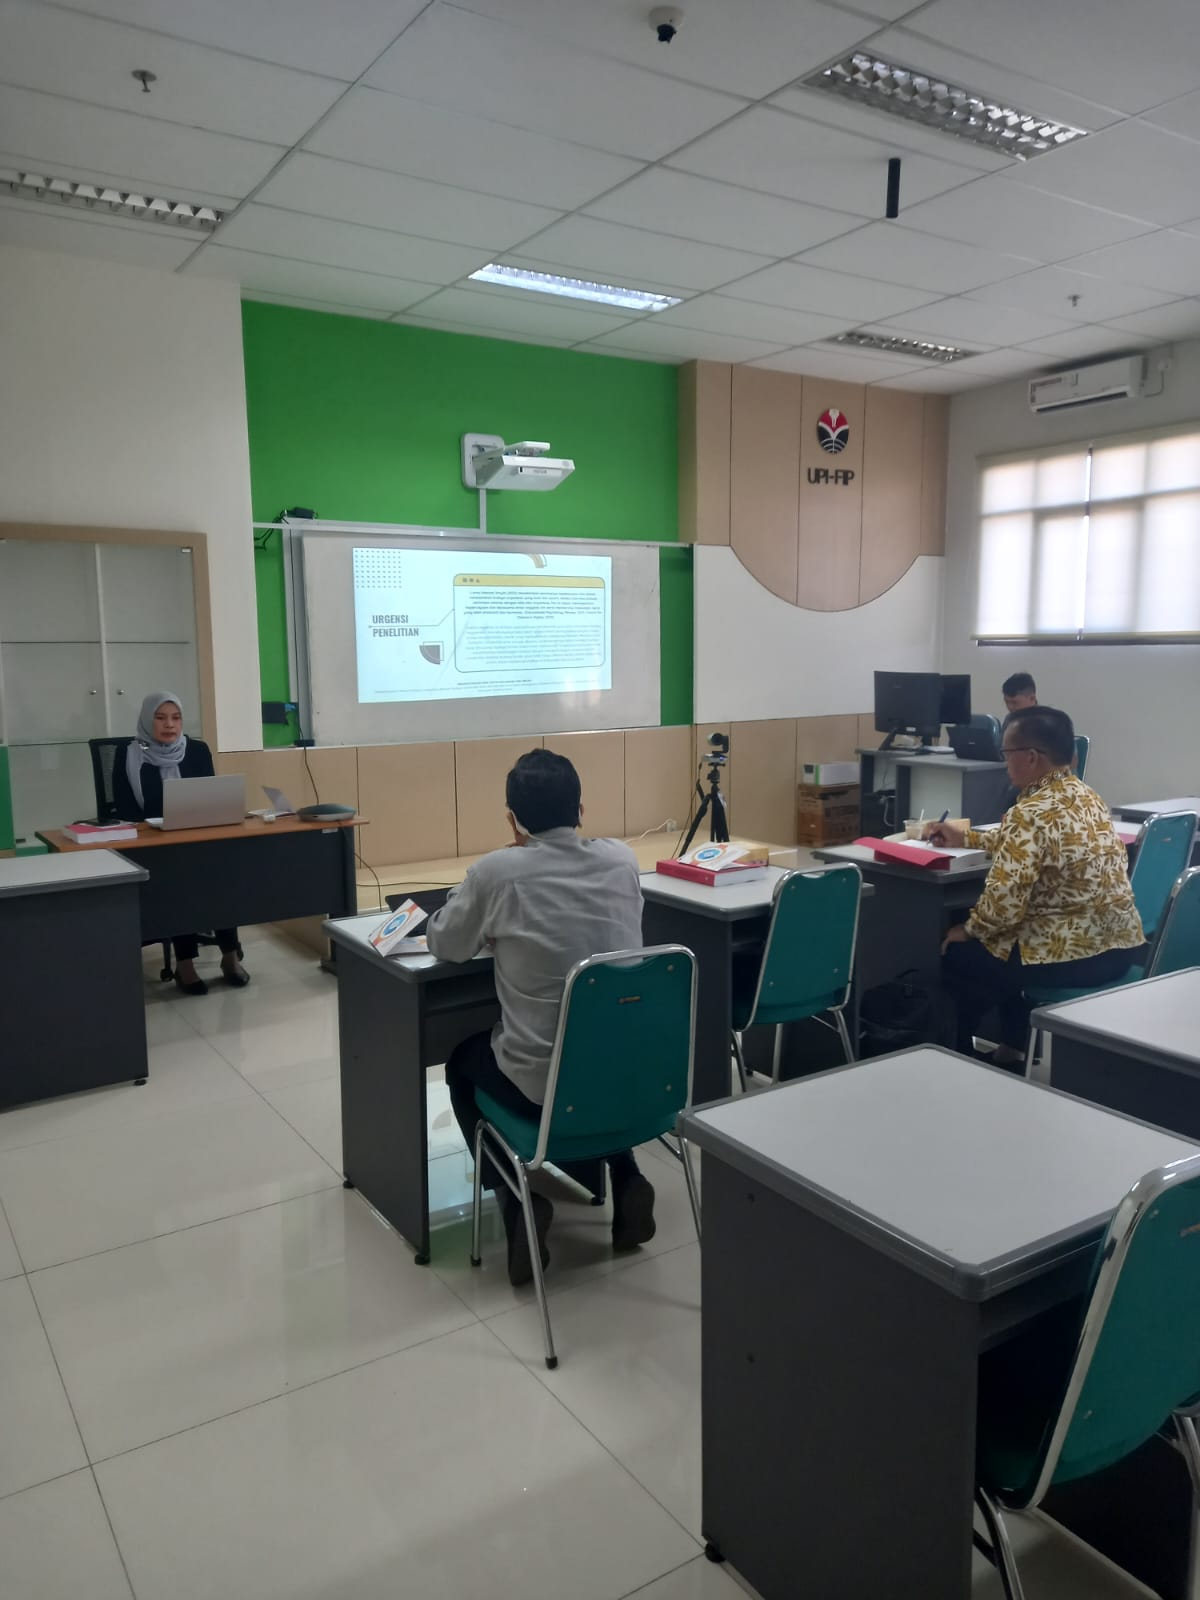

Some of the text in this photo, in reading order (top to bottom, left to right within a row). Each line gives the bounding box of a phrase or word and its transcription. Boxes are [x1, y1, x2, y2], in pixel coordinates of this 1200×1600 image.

[807, 467, 855, 485] UPI-FIP
[372, 614, 409, 624] URGENSI
[372, 628, 419, 637] PENELITIAN
